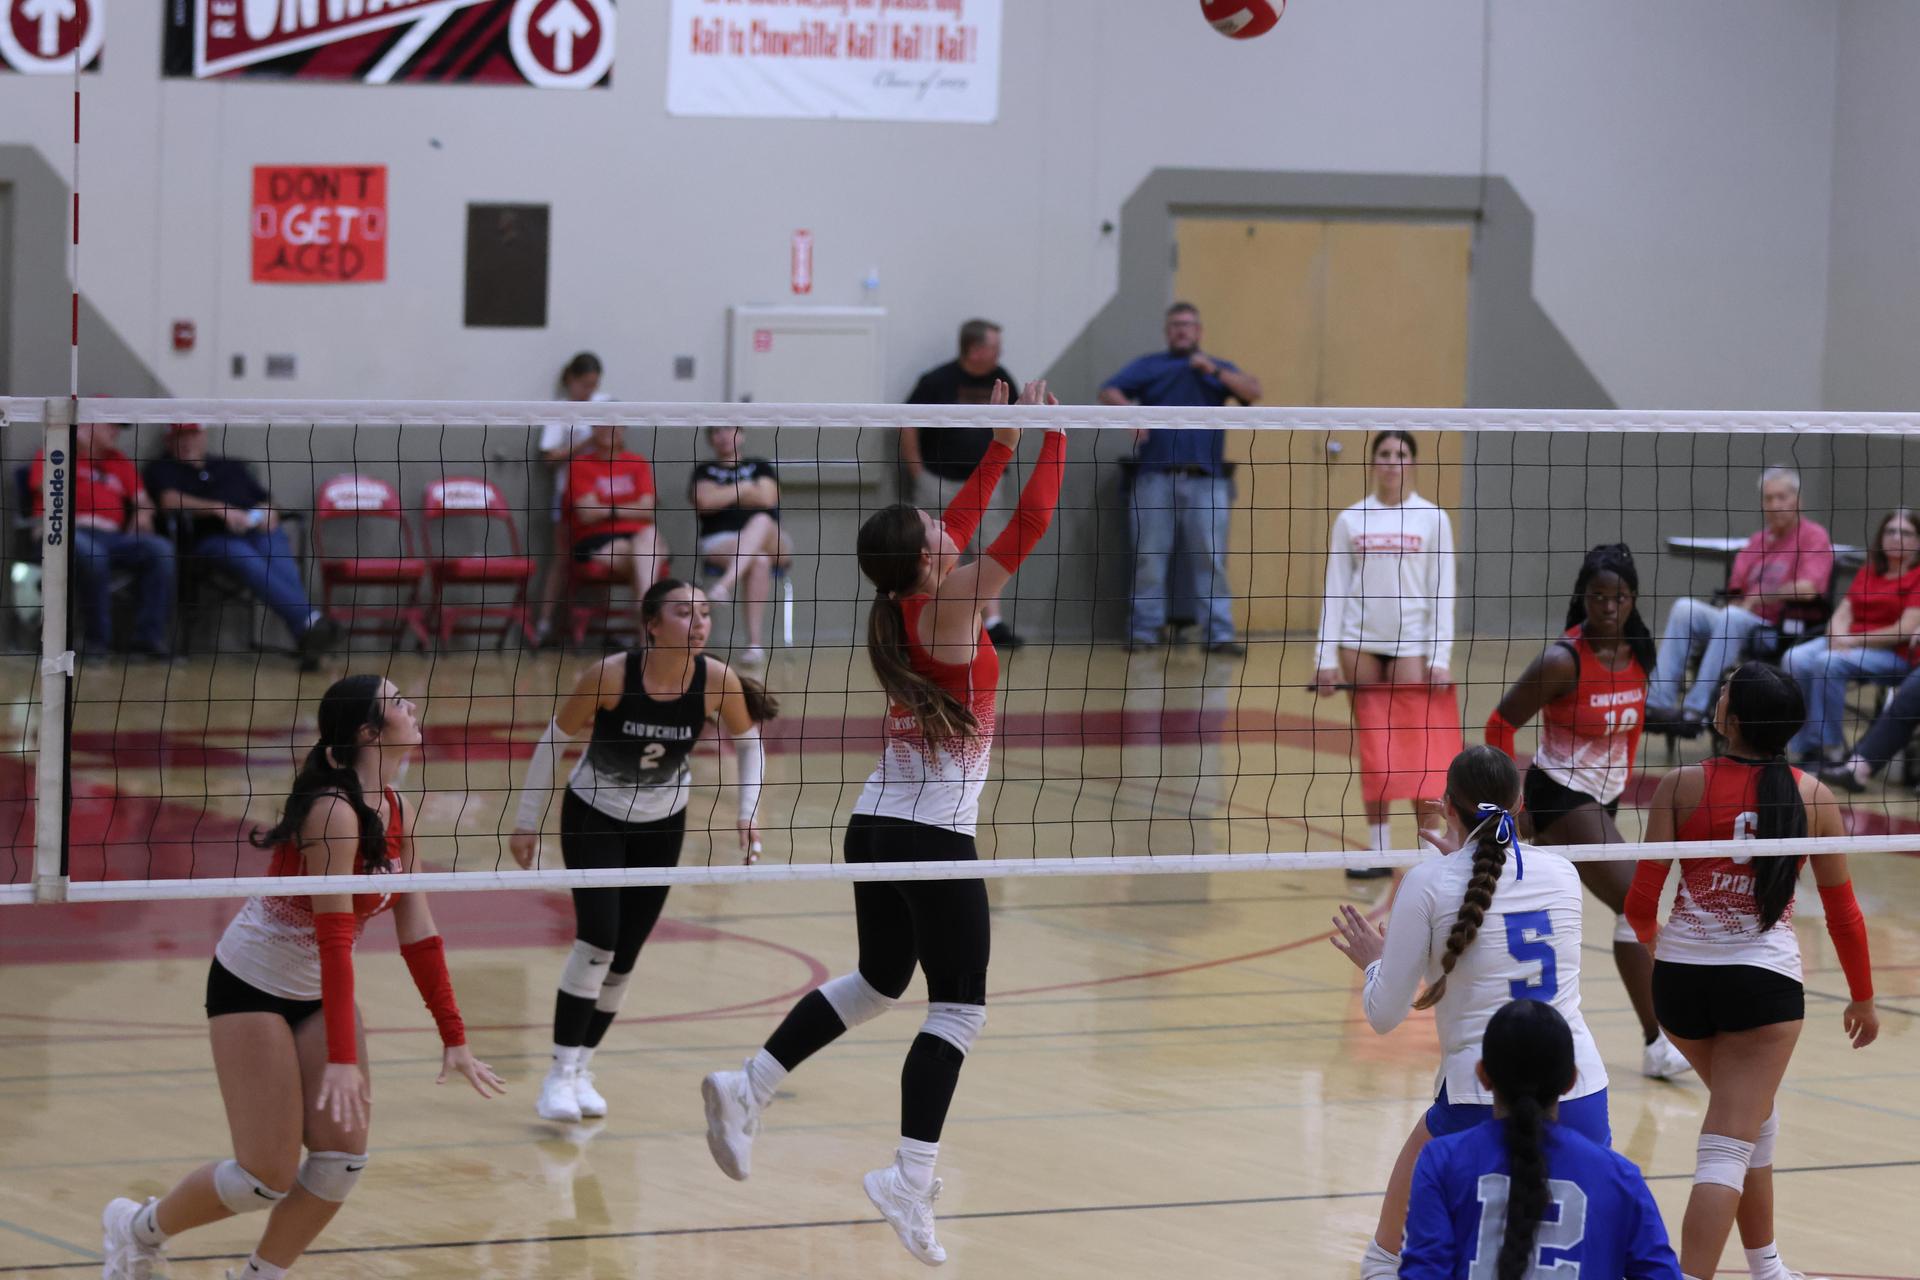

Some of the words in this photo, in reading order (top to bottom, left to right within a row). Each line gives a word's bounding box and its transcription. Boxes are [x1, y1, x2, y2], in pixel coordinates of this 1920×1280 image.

[281, 203, 360, 245] GET
[263, 242, 365, 280] ACED
[48, 468, 65, 546] Schelde
[622, 720, 693, 740] CHOWCHILLA
[639, 742, 667, 770] 2
[1503, 909, 1559, 1000] 5
[1468, 1172, 1588, 1280] 12
